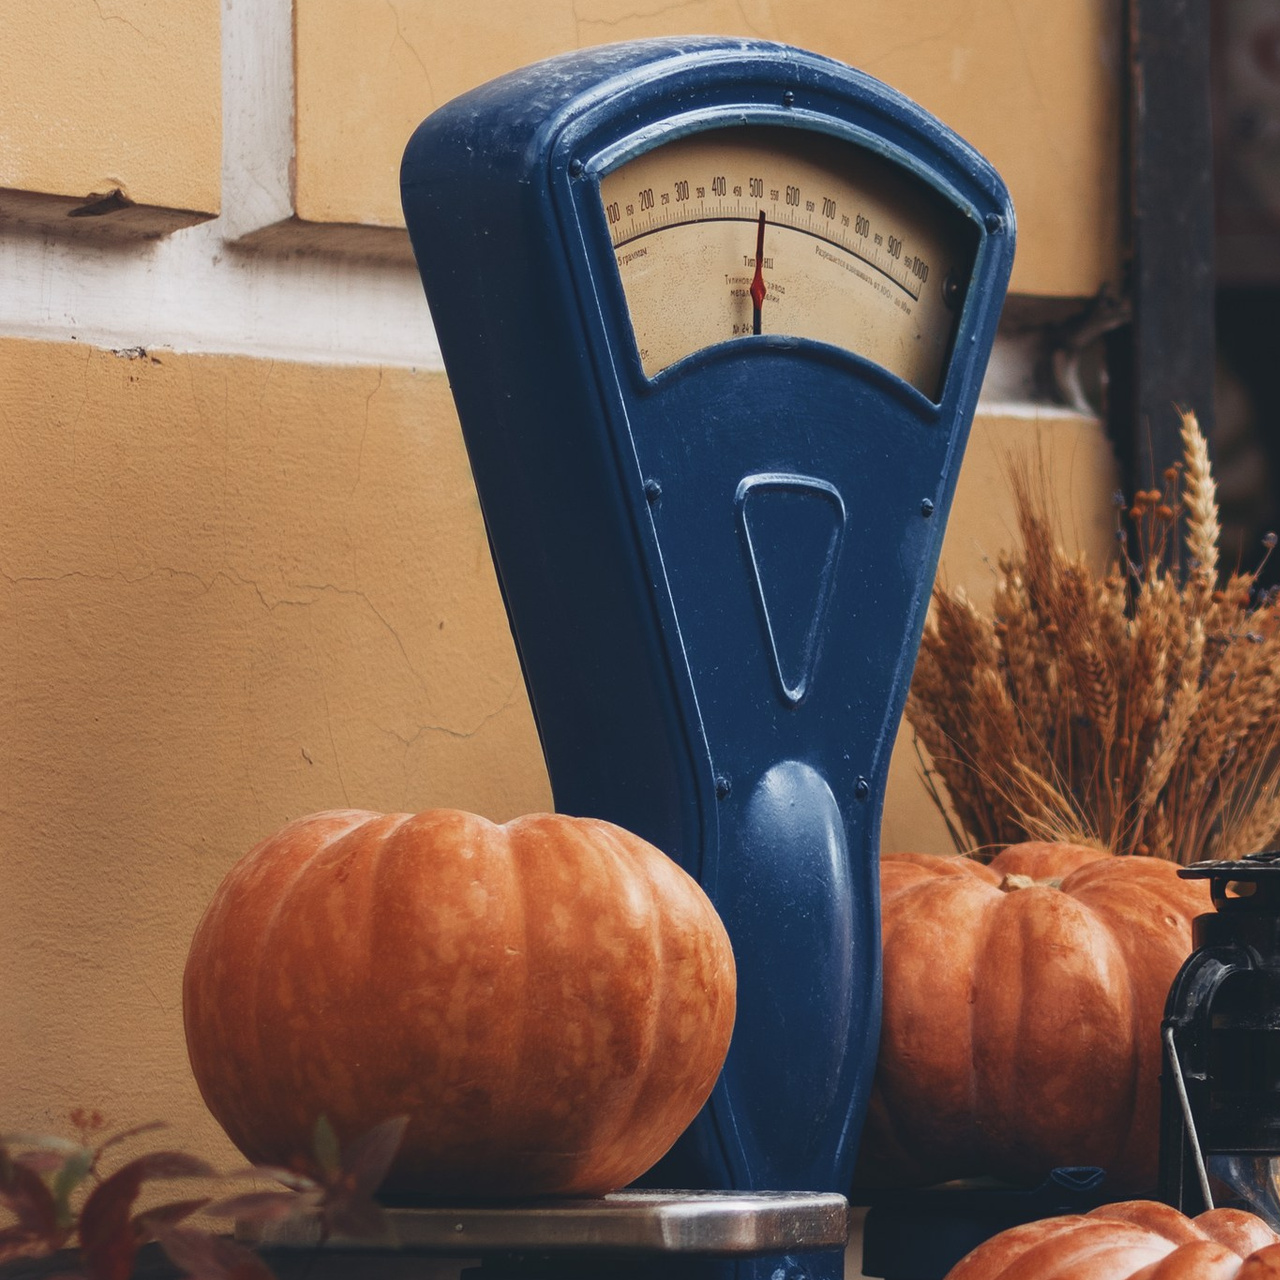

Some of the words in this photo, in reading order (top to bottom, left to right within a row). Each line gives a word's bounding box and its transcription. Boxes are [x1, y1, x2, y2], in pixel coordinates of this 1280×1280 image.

[606, 201, 621, 225] 100
[638, 188, 655, 212] 200
[660, 193, 670, 206] 250
[674, 179, 690, 203] 300
[696, 186, 705, 199] 350
[711, 176, 727, 197] 400
[732, 185, 742, 197] 450
[749, 177, 764, 199] 500
[770, 189, 779, 202] 550
[785, 184, 800, 207] 600
[805, 200, 815, 213] 650
[822, 196, 836, 220] 700
[840, 213, 850, 228] 750
[855, 214, 870, 239] 800
[874, 233, 883, 247] 850
[887, 235, 902, 260] 900
[912, 256, 929, 283] 1000
